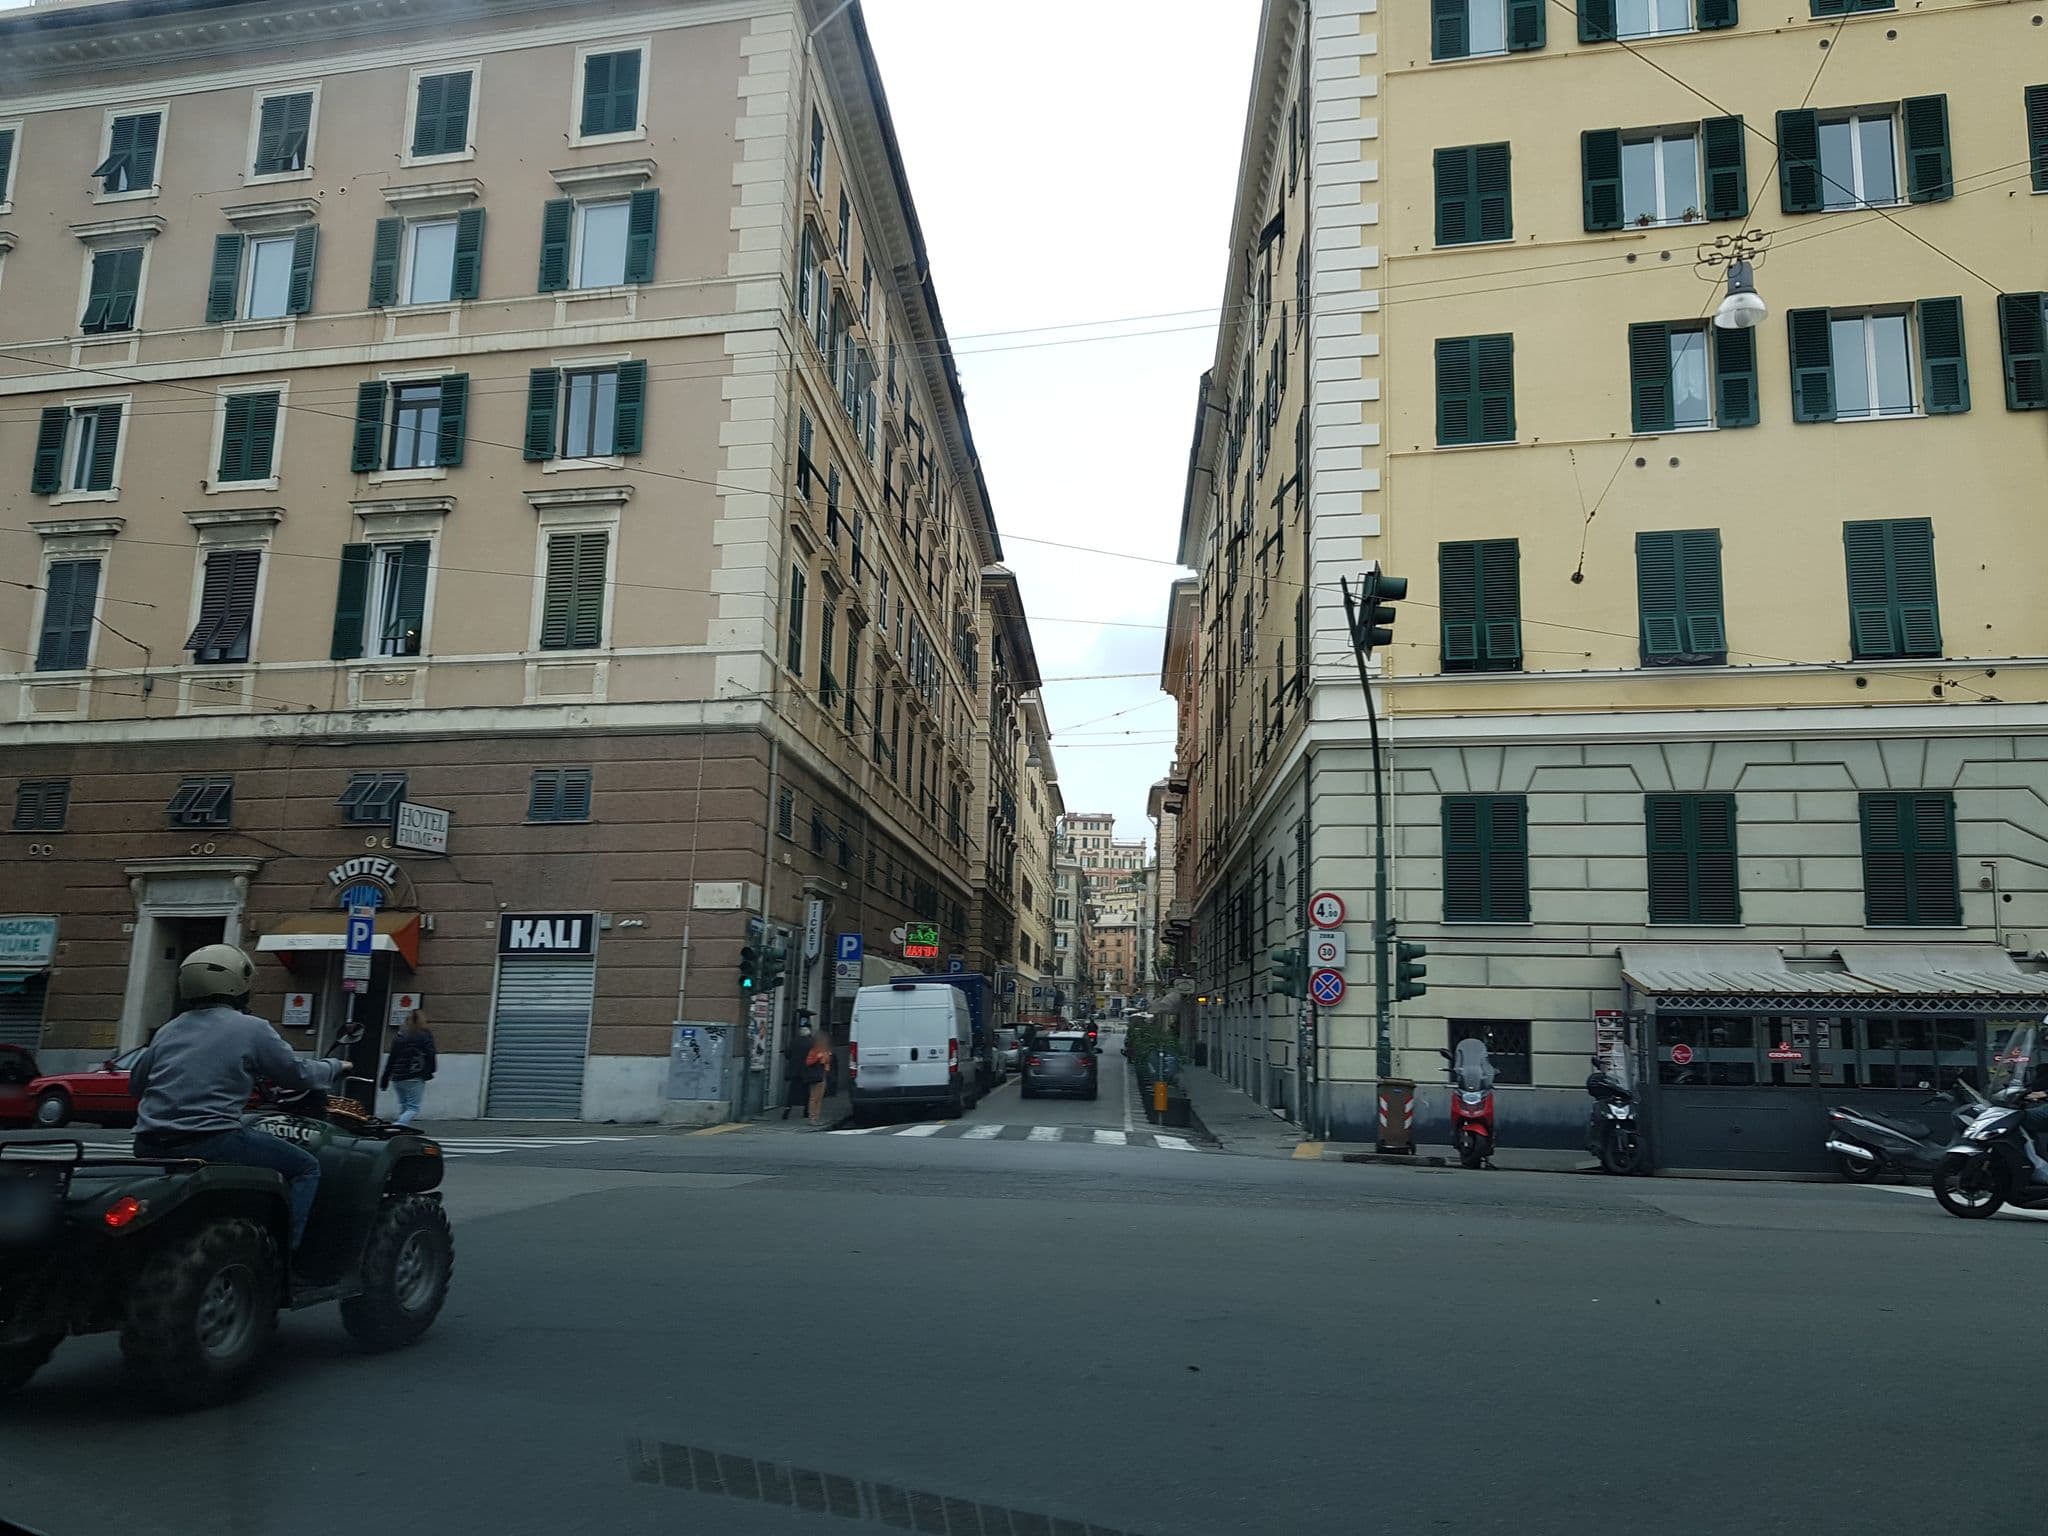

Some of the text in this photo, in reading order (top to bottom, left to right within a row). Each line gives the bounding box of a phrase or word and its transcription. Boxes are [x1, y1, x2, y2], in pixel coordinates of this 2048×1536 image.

[400, 807, 445, 832] HOTEL
[328, 857, 399, 885] HOTEL
[351, 922, 369, 950] P
[509, 919, 582, 949] KALI
[809, 903, 818, 951] TICKET
[841, 936, 858, 958] P
[1321, 948, 1333, 956] 30
